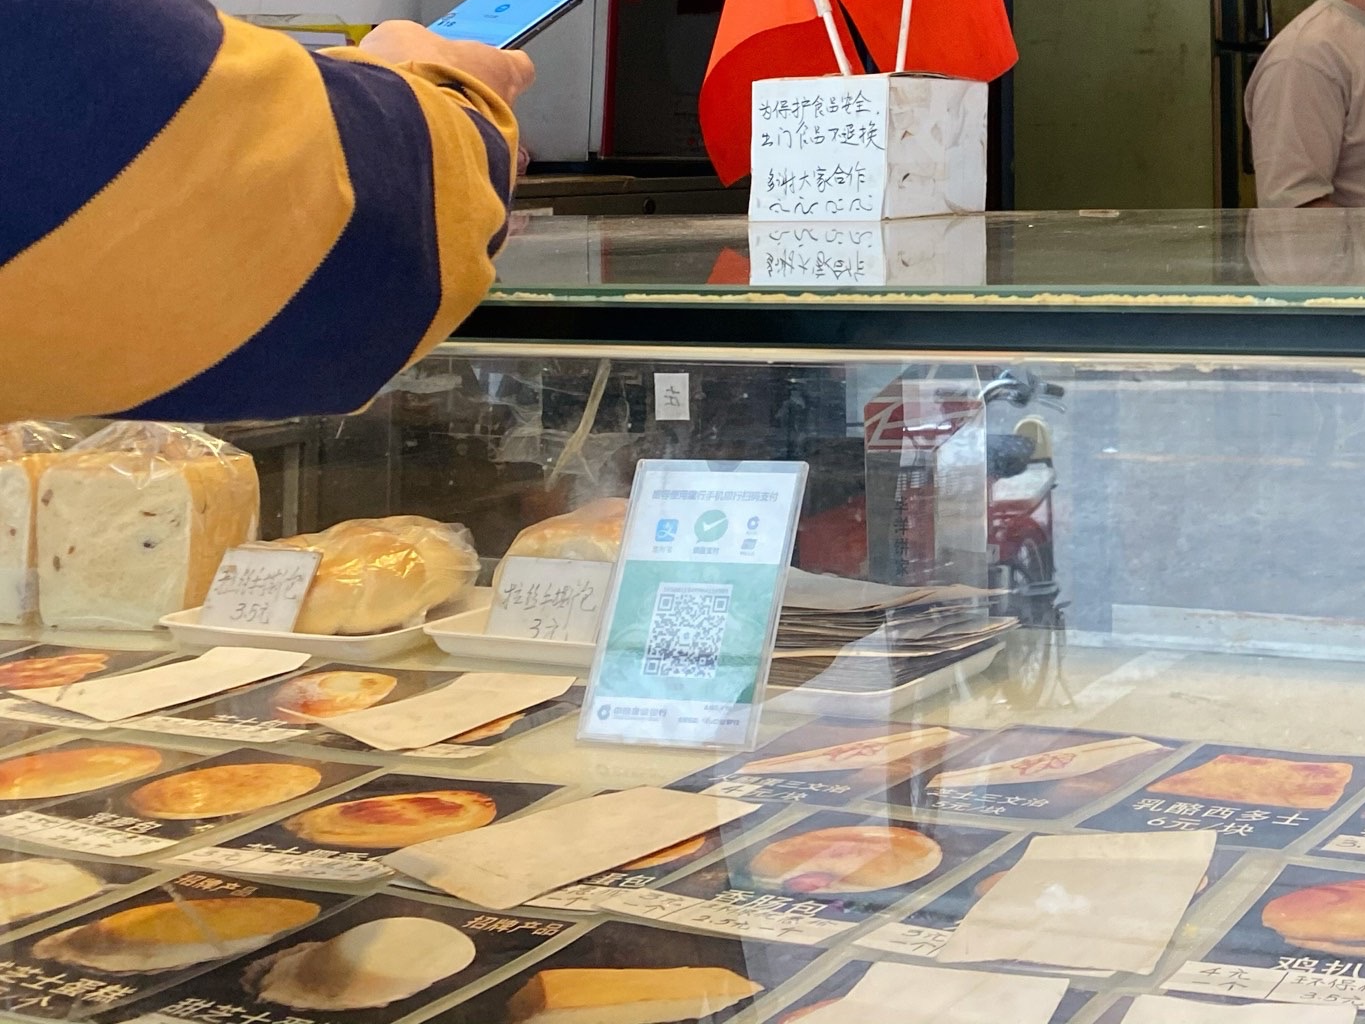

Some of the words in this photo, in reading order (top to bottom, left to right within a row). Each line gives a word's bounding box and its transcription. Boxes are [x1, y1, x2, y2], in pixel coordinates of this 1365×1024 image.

[766, 161, 867, 195] 多谢大家合作
[1131, 796, 1310, 827] 乳酪西多士
[1145, 815, 1256, 838] 6元/块
[711, 888, 829, 917] 香肠包
[461, 913, 566, 937] 招牌产品
